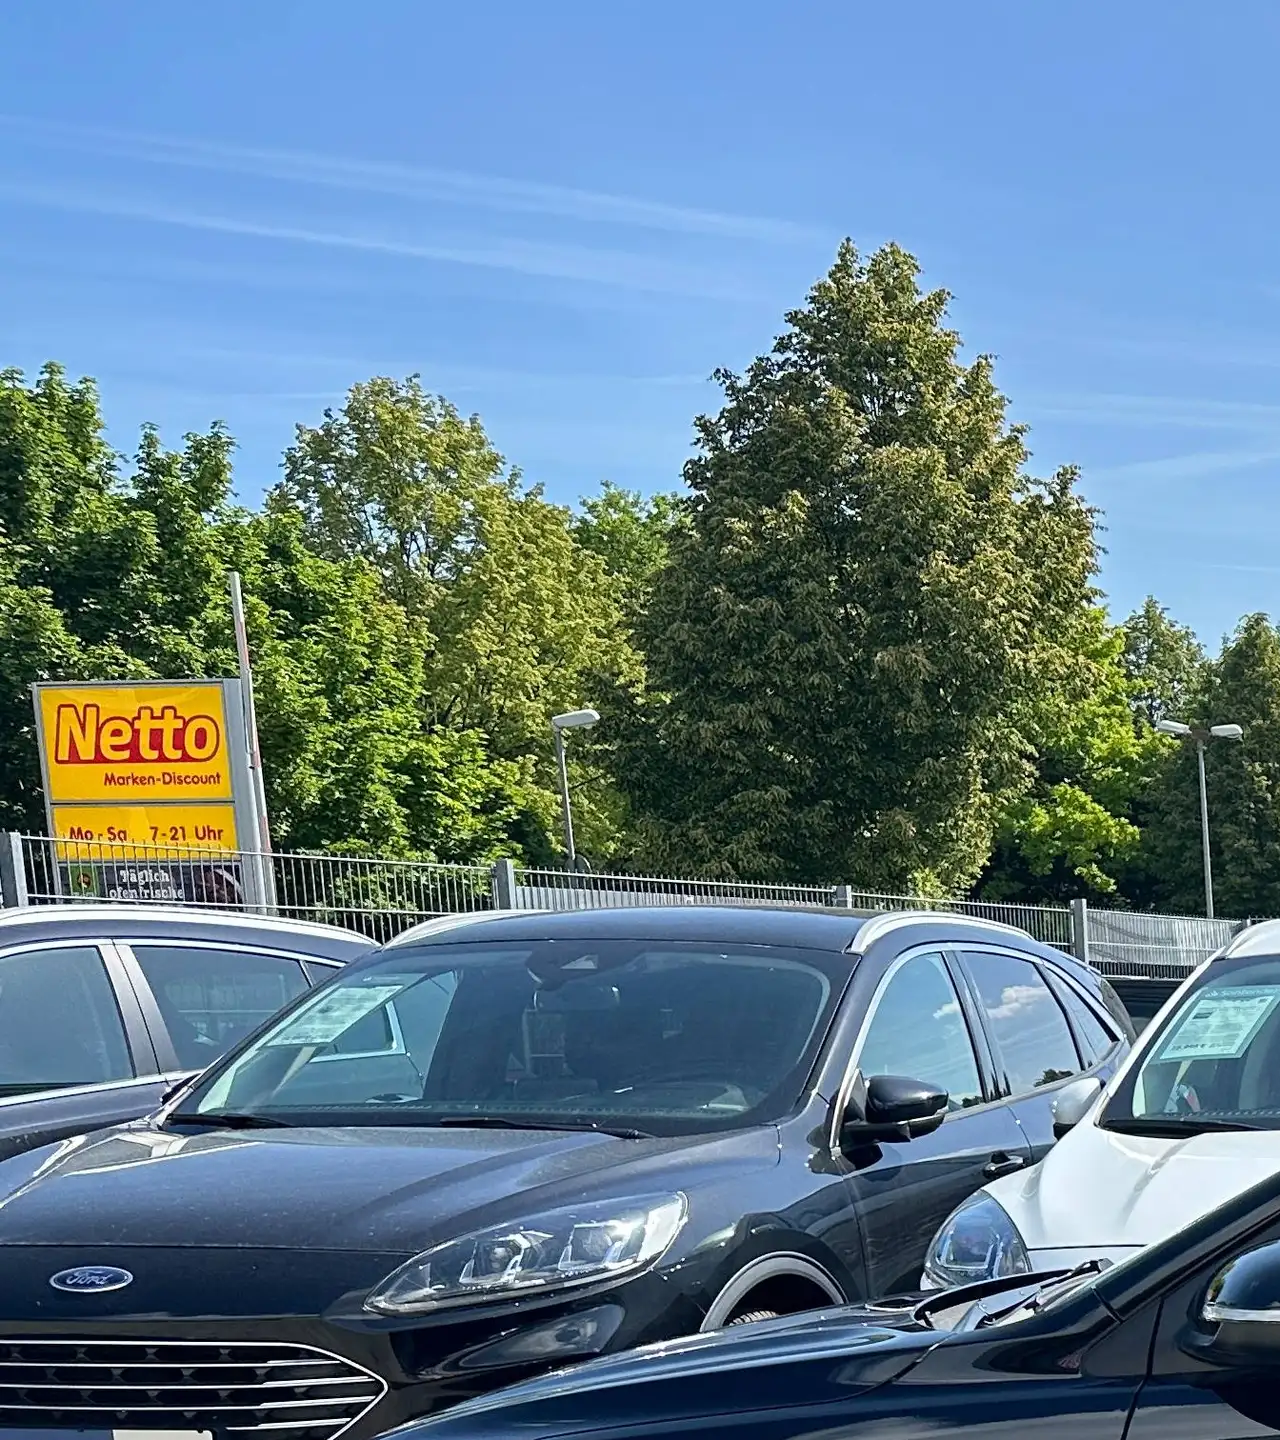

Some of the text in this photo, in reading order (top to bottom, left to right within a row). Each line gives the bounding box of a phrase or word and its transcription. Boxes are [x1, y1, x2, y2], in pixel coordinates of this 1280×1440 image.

[55, 703, 220, 764] Netto
[104, 772, 221, 786] Marken-Discount
[195, 825, 224, 841] Uhr
